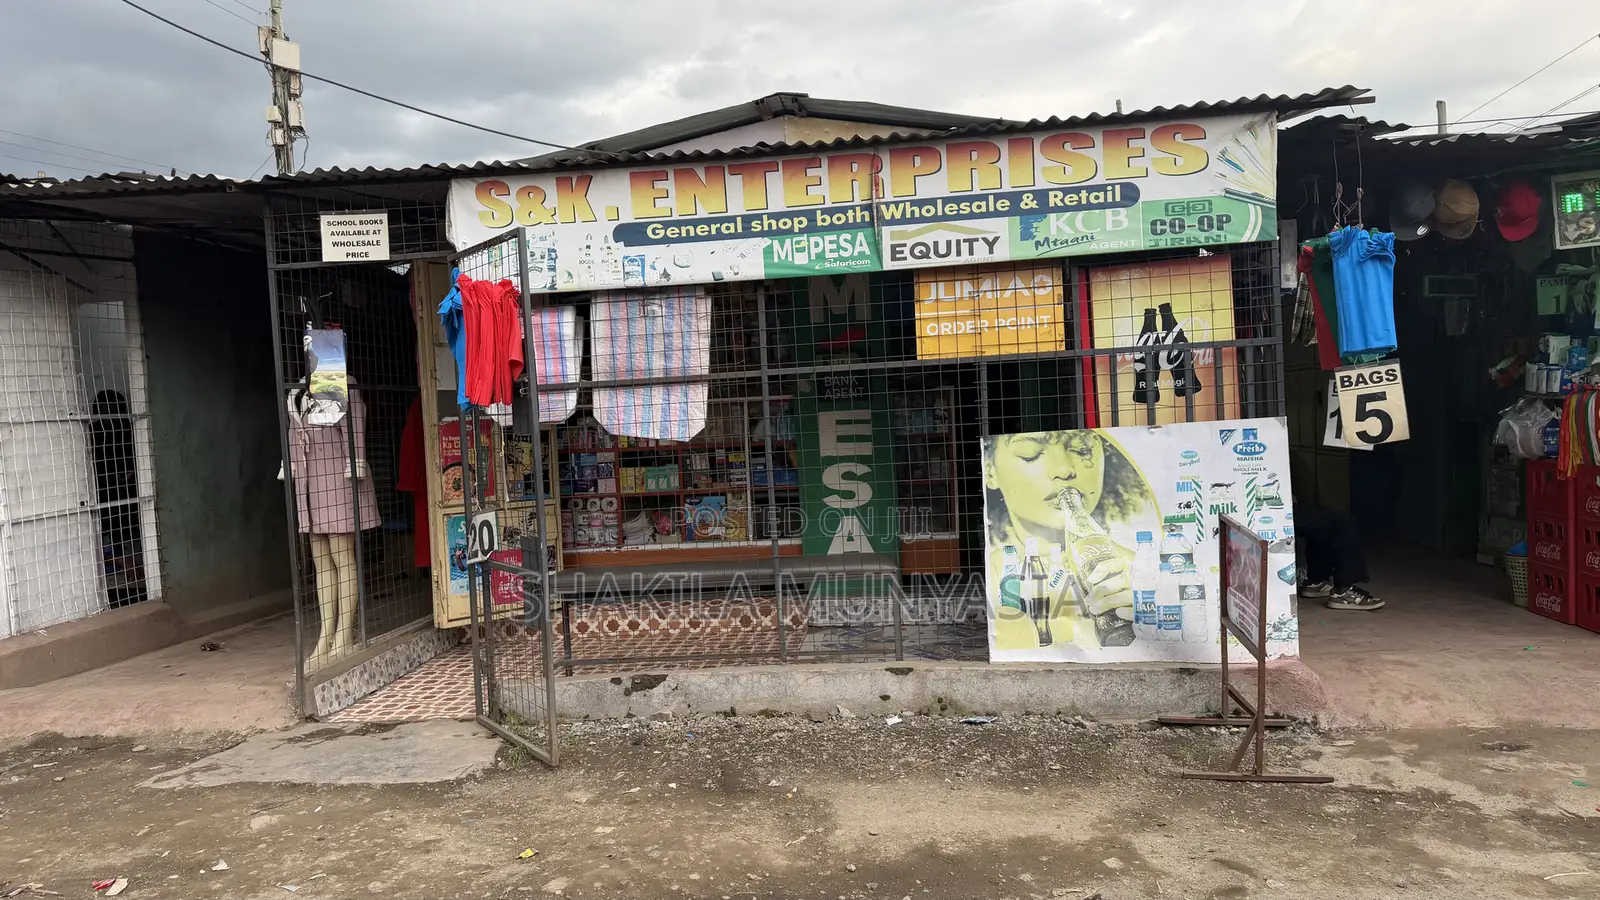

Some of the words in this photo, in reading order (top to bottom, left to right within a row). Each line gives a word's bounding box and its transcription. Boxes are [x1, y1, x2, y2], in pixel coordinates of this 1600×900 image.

[629, 122, 1210, 219] ENTERPRISES
[646, 217, 744, 240] General
[750, 211, 808, 236] shop
[815, 206, 870, 226] both
[880, 193, 1011, 221] Wholesale
[1019, 192, 1039, 210] &
[1048, 185, 1121, 208] Retail
[1049, 207, 1130, 235] KCB
[1149, 213, 1232, 236] CO-OP
[331, 240, 381, 248] WHOLESALE
[890, 236, 1001, 262] EQUITY
[1034, 232, 1096, 251] Mtaani
[1088, 239, 1138, 250] AGENT
[824, 259, 871, 268] Safaricom
[926, 318, 989, 336] ORDER
[994, 315, 1051, 331] POINT
[1339, 368, 1398, 388] BAGS
[1355, 391, 1393, 444] 5
[1176, 481, 1194, 492] MIL
[1209, 502, 1238, 515] Milk
[1258, 530, 1277, 540] MILK
[1049, 569, 1064, 588] Fanta
